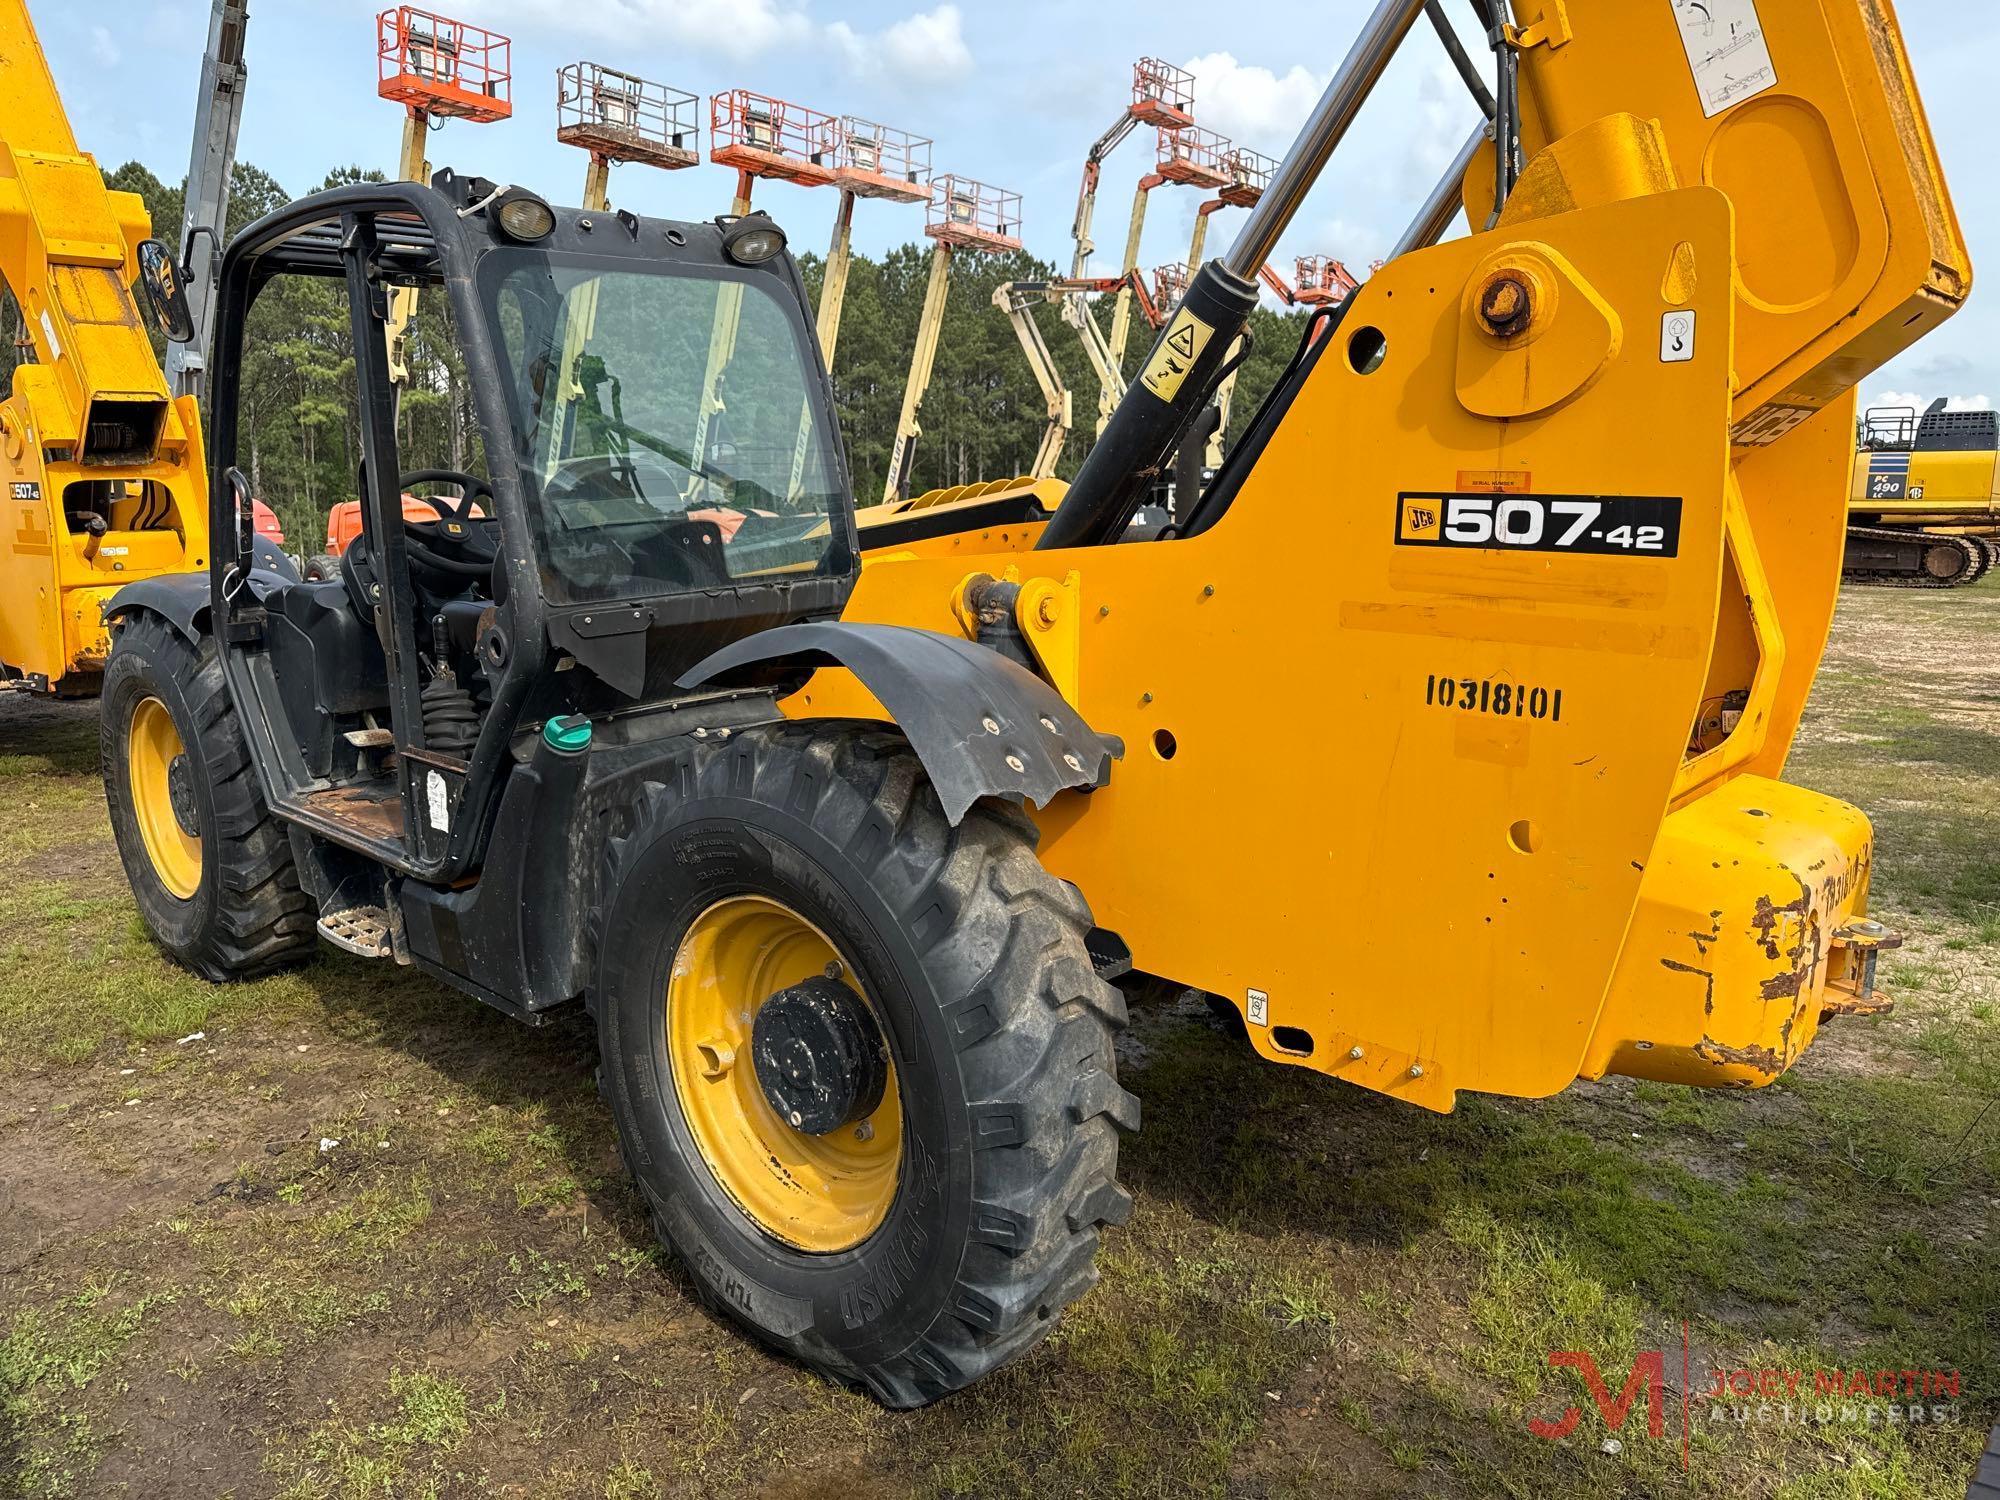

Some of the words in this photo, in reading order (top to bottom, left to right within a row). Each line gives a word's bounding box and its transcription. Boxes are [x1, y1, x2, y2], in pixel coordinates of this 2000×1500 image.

[555, 401, 564, 437] LIFT
[697, 414, 706, 447] LIFT
[797, 428, 807, 457] LIFT
[894, 435, 904, 464] LIFT
[1872, 482, 1900, 493] 490
[1874, 475, 1889, 483] PC
[1409, 506, 1436, 531] JCB
[1445, 499, 1665, 550] 507-42
[1426, 674, 1562, 722] 10318101
[693, 1244, 725, 1286] 532
[839, 1207, 929, 1329] CAMSO
[724, 1277, 754, 1313] TLH
